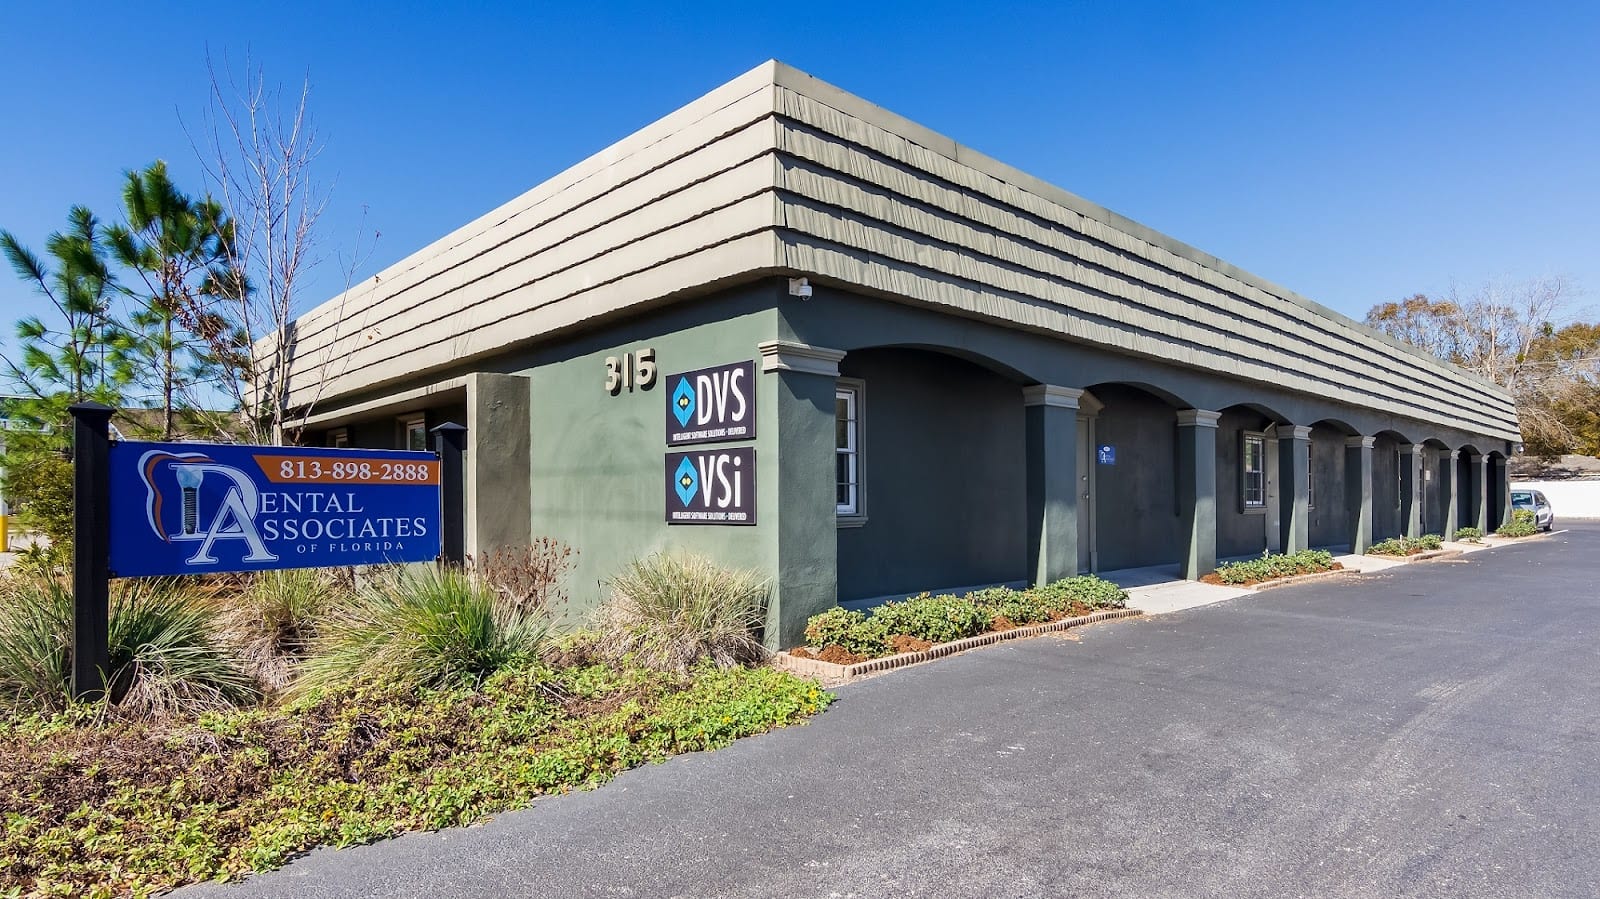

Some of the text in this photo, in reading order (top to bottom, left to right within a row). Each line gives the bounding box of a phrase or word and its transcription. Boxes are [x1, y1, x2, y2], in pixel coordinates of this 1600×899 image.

[605, 347, 657, 391] 315
[696, 368, 746, 425] DVS
[280, 460, 429, 481] 813-898-2888
[698, 454, 741, 508] VSi
[297, 541, 405, 553] OF FLORIDA
